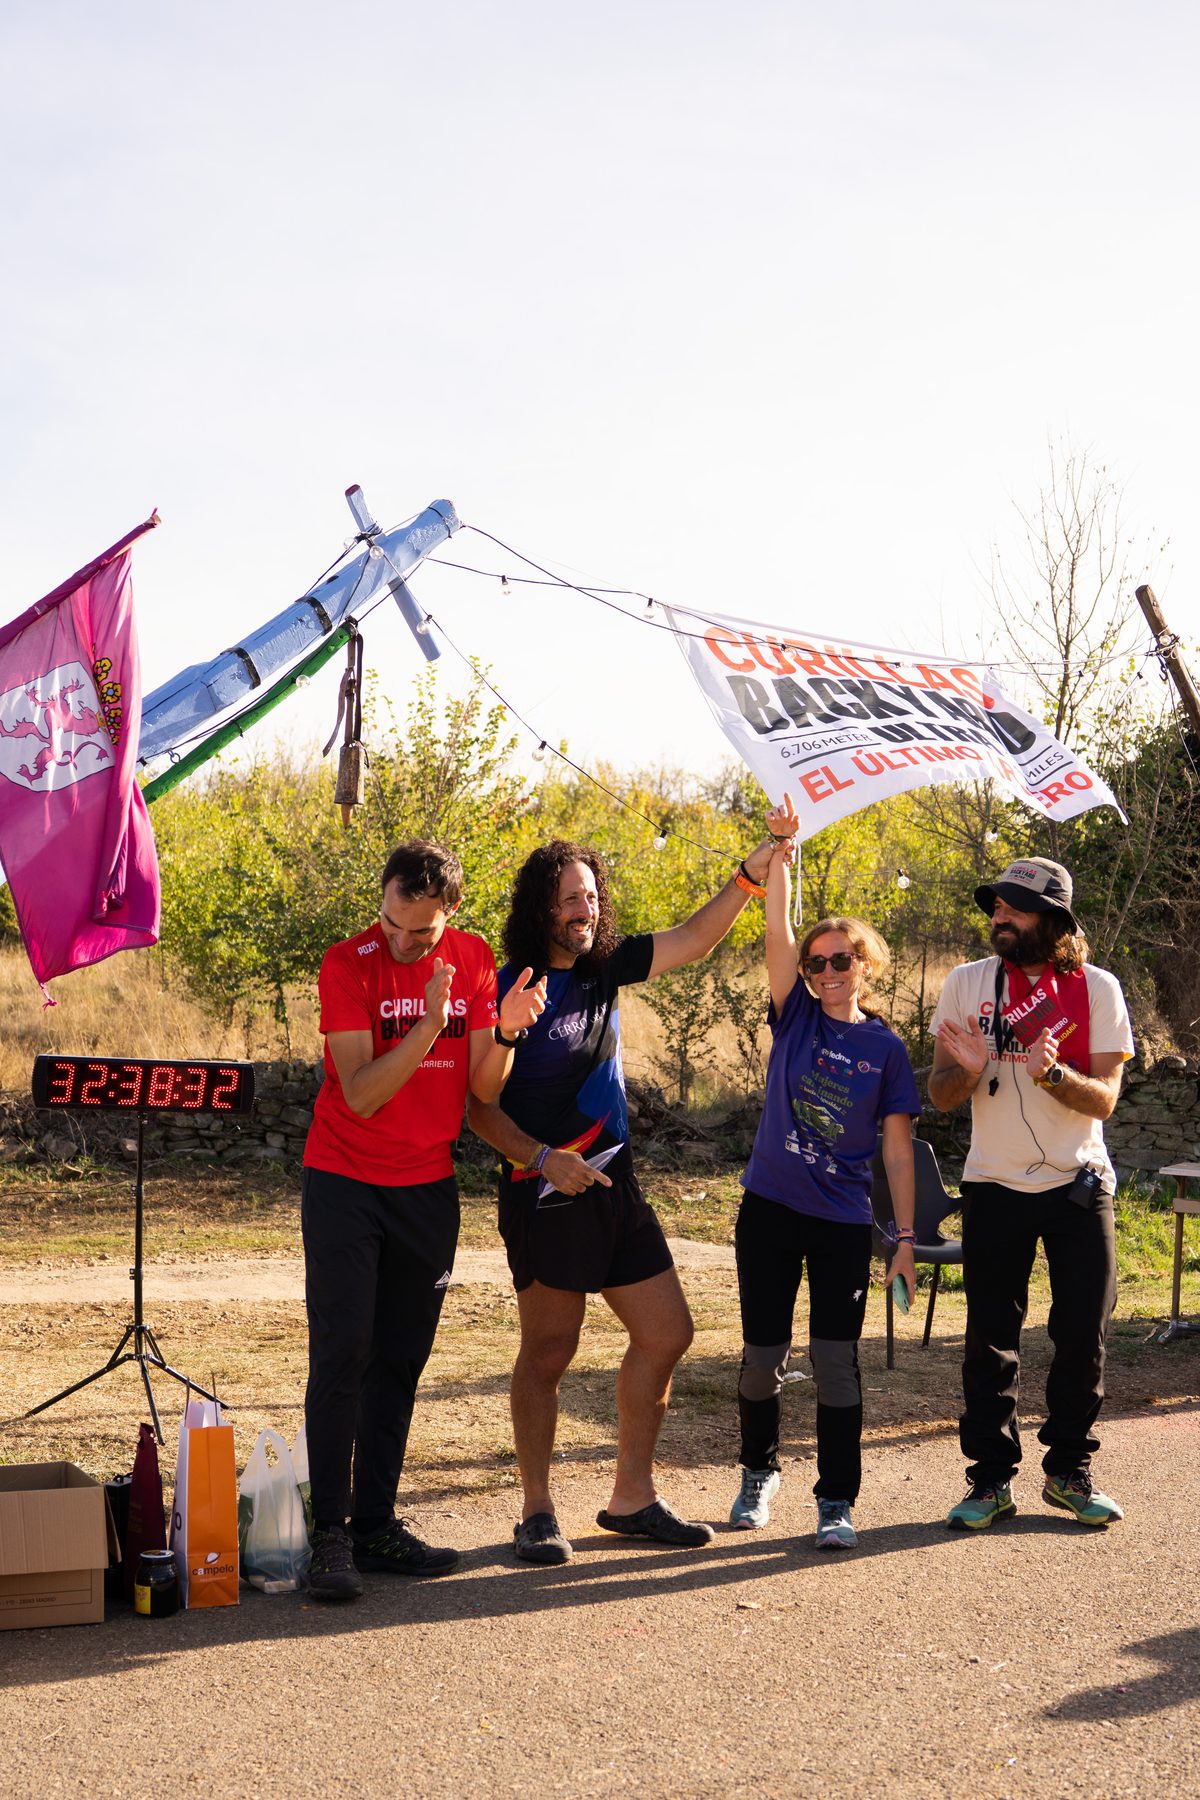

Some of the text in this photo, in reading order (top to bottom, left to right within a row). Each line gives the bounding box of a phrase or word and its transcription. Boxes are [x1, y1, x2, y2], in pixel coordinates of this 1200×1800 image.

[704, 626, 995, 710] CURILLAS
[726, 675, 1036, 755] BACKYARD
[780, 739, 822, 759] 6.706
[798, 765, 855, 804] EL
[851, 745, 983, 776] ÚLTIMO
[1026, 752, 1064, 778] MILES
[380, 998, 467, 1018] CURILAS
[1006, 988, 1047, 1026] RILLAS
[381, 1017, 466, 1040] BACRD
[548, 1017, 588, 1040] CERRO
[50, 1063, 239, 1109] 32:38:32
[801, 1074, 853, 1107] cainando
[192, 1564, 234, 1576] campelo
